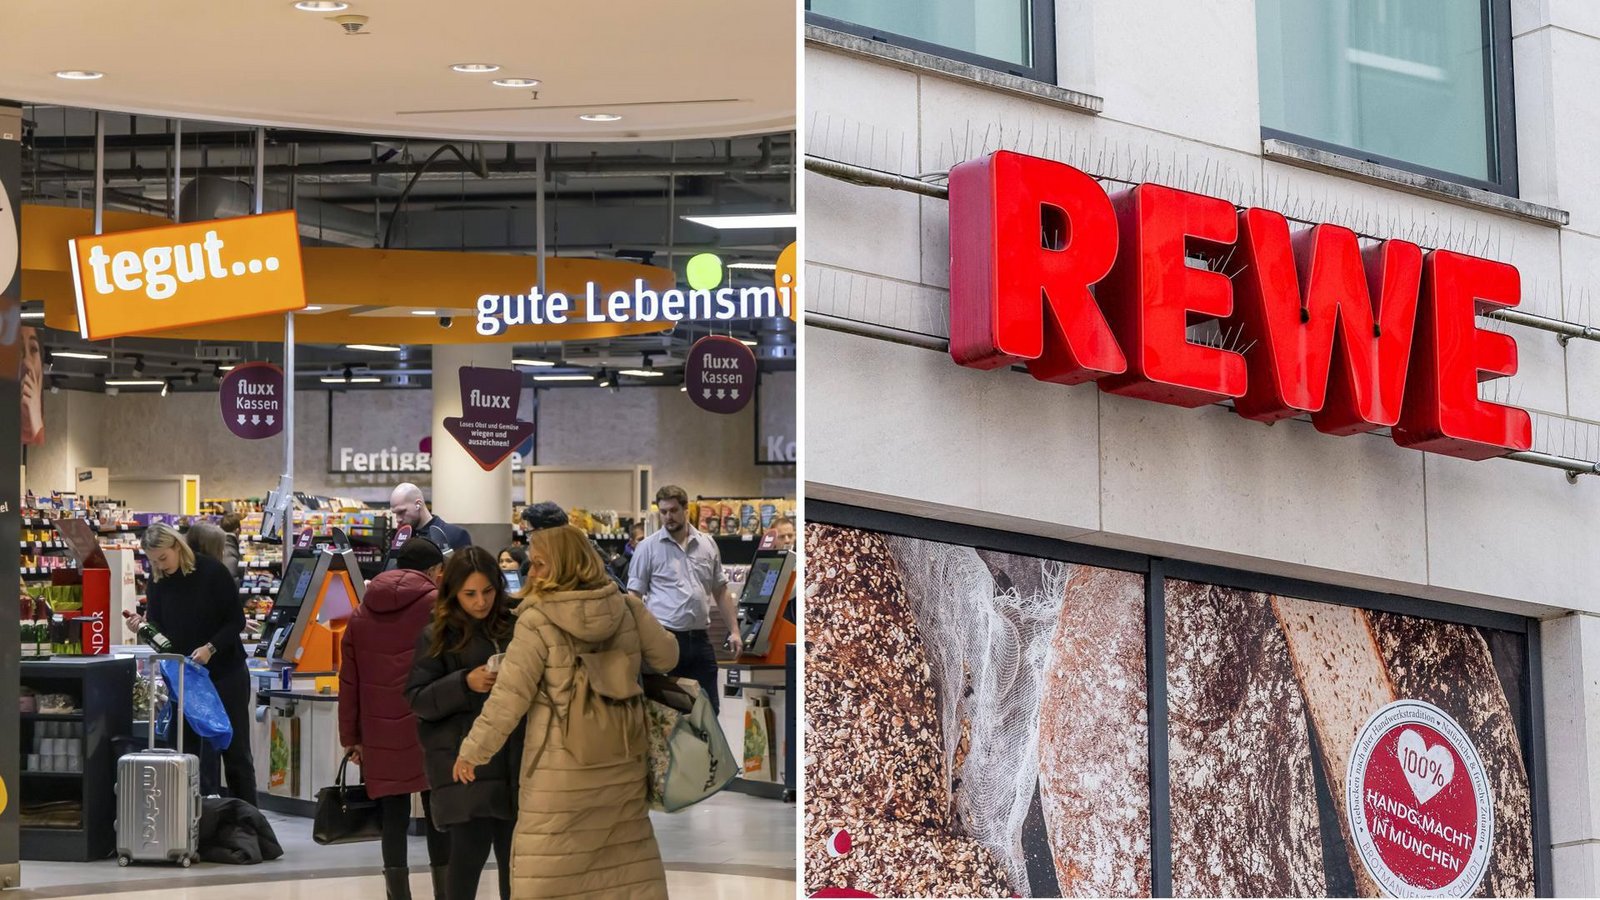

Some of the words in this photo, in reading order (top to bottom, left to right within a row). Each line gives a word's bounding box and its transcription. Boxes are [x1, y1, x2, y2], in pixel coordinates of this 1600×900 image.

[88, 230, 280, 300] tegut...
[476, 286, 569, 336] gute
[586, 273, 797, 324] Lebensmi
[949, 150, 1532, 461] REWE
[702, 353, 739, 369] fluxx
[238, 379, 275, 395] fluxx
[701, 370, 743, 384] Kassen
[236, 396, 278, 410] Kassen
[470, 389, 511, 409] fluxx
[471, 429, 494, 439] wiegen
[494, 430, 508, 439] und
[474, 421, 487, 429] Obst
[487, 422, 498, 430] und
[498, 423, 519, 431] Gemüse
[468, 438, 510, 447] auszeichnen!
[92, 611, 104, 655] NDOR
[1371, 709, 1436, 736] Handwerkstradition
[1362, 735, 1375, 753] alter
[1355, 753, 1366, 775] nach
[1403, 746, 1445, 787] 100%
[1440, 721, 1472, 761] Natürliche
[1469, 761, 1477, 770] &
[1473, 770, 1485, 805] frische
[1480, 806, 1488, 843] Zutaten
[1352, 775, 1362, 826] Gebacken
[1371, 816, 1388, 839] IN
[1389, 826, 1461, 873] MÜNCHEN
[1448, 858, 1481, 898] SCHMIDT
